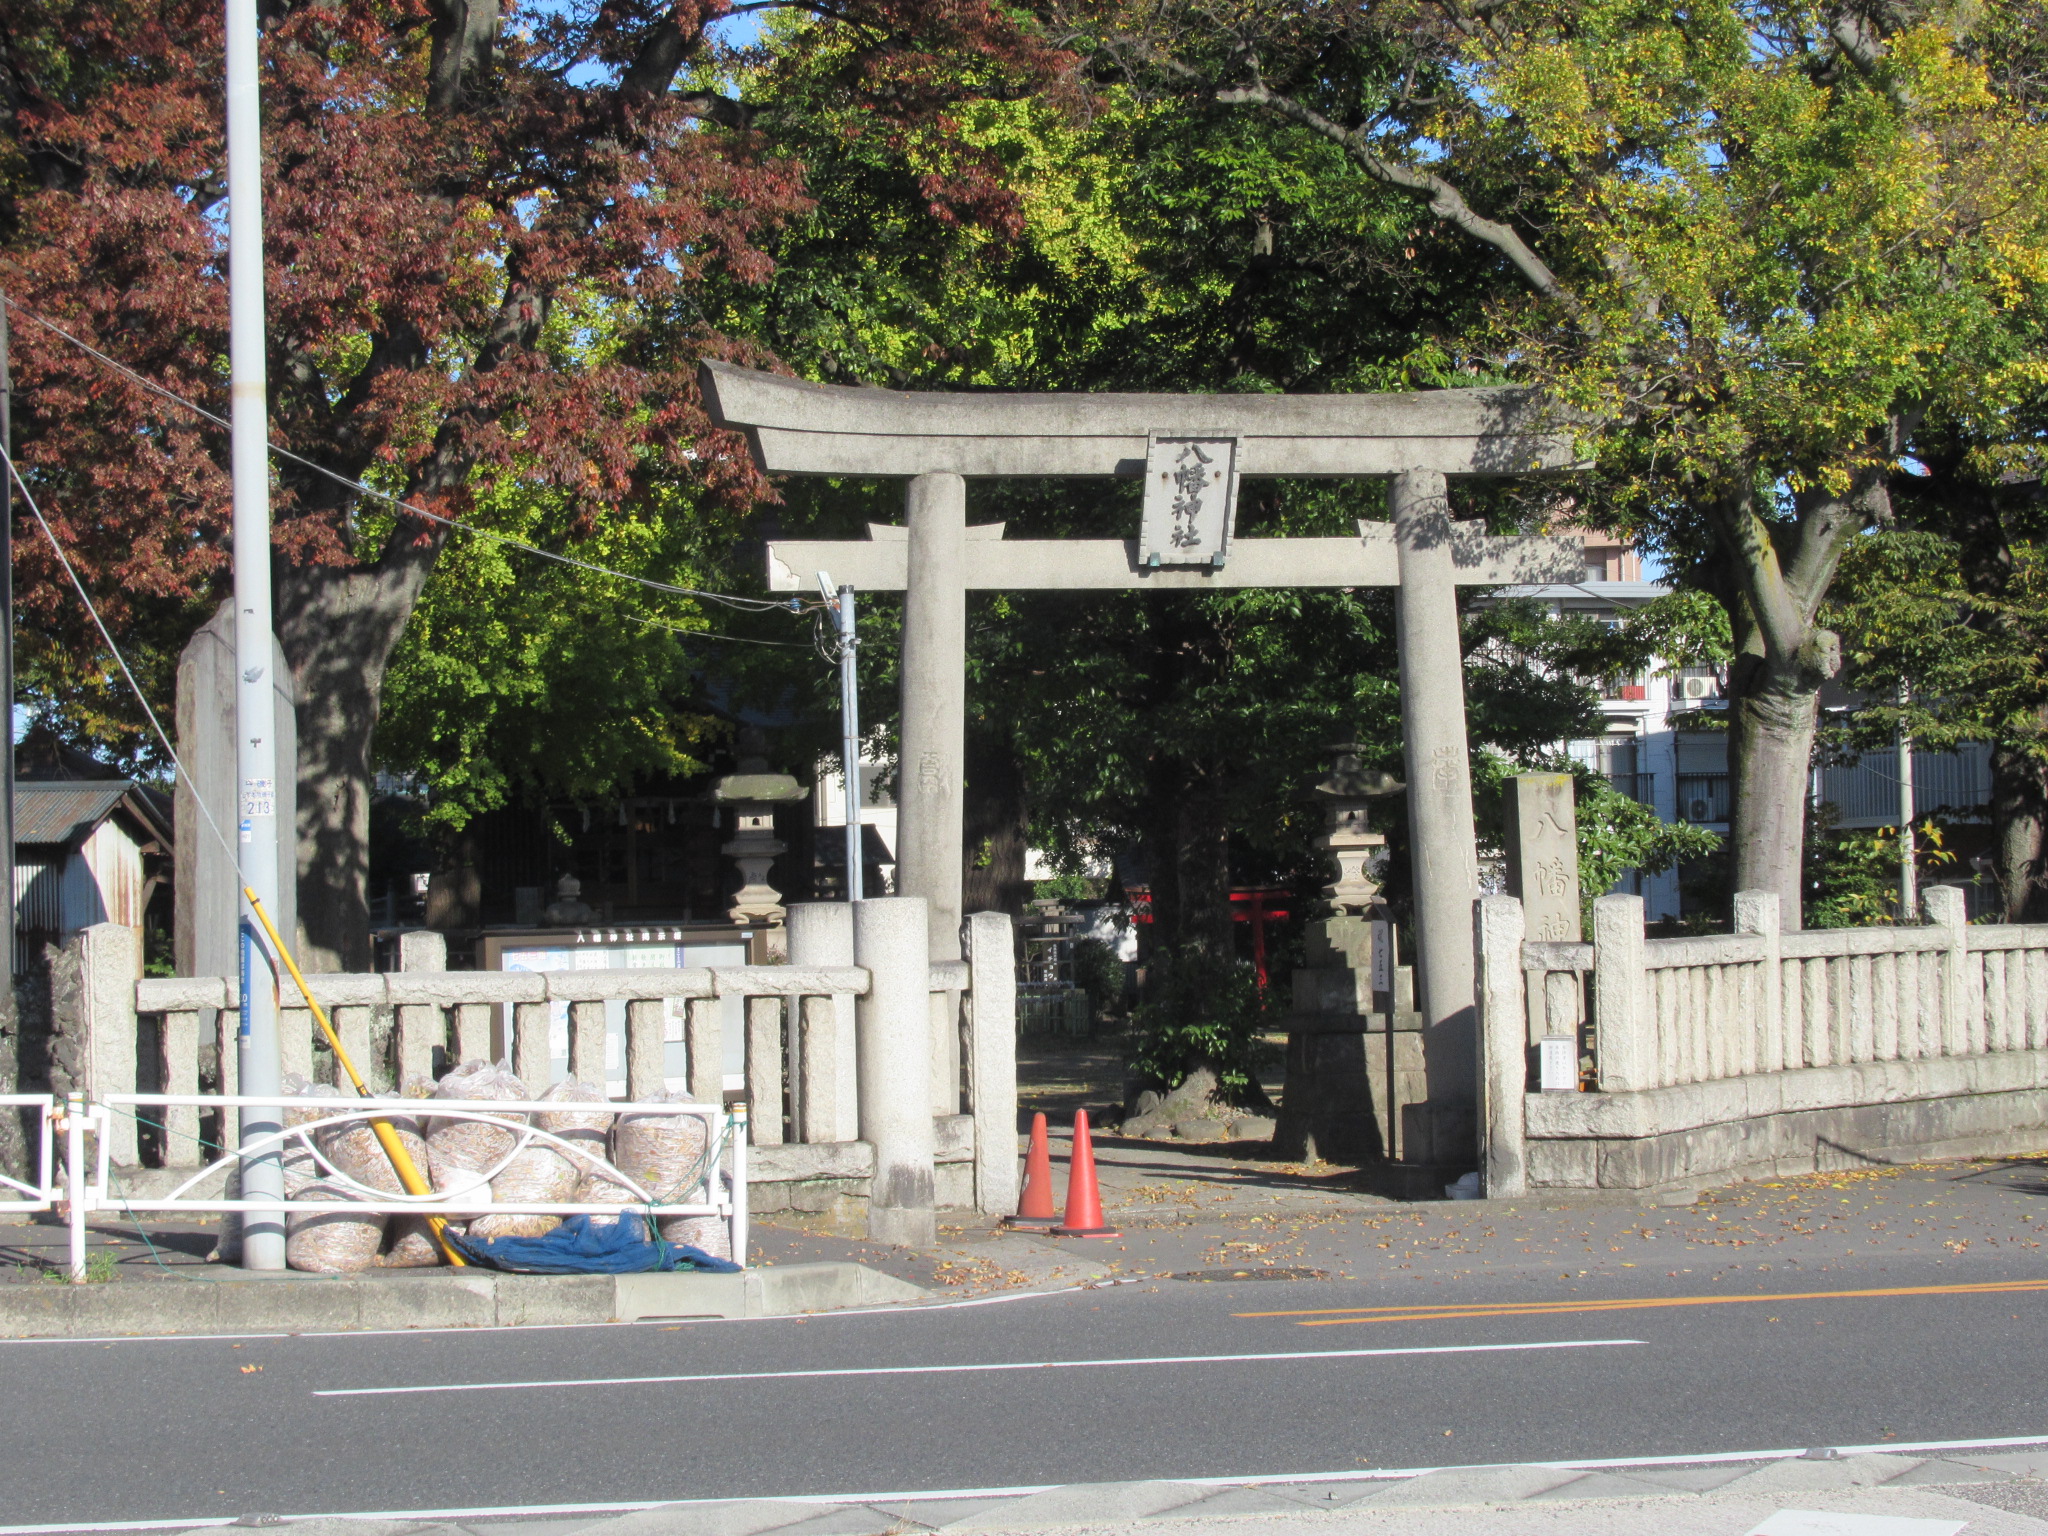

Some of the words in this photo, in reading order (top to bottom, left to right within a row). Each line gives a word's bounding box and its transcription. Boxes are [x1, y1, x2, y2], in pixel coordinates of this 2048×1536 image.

[1170, 443, 1214, 548] 八幡神社
[248, 802, 270, 814] 213
[1534, 811, 1570, 941] 八幡神
[577, 932, 682, 943] 八幡神社掲示板
